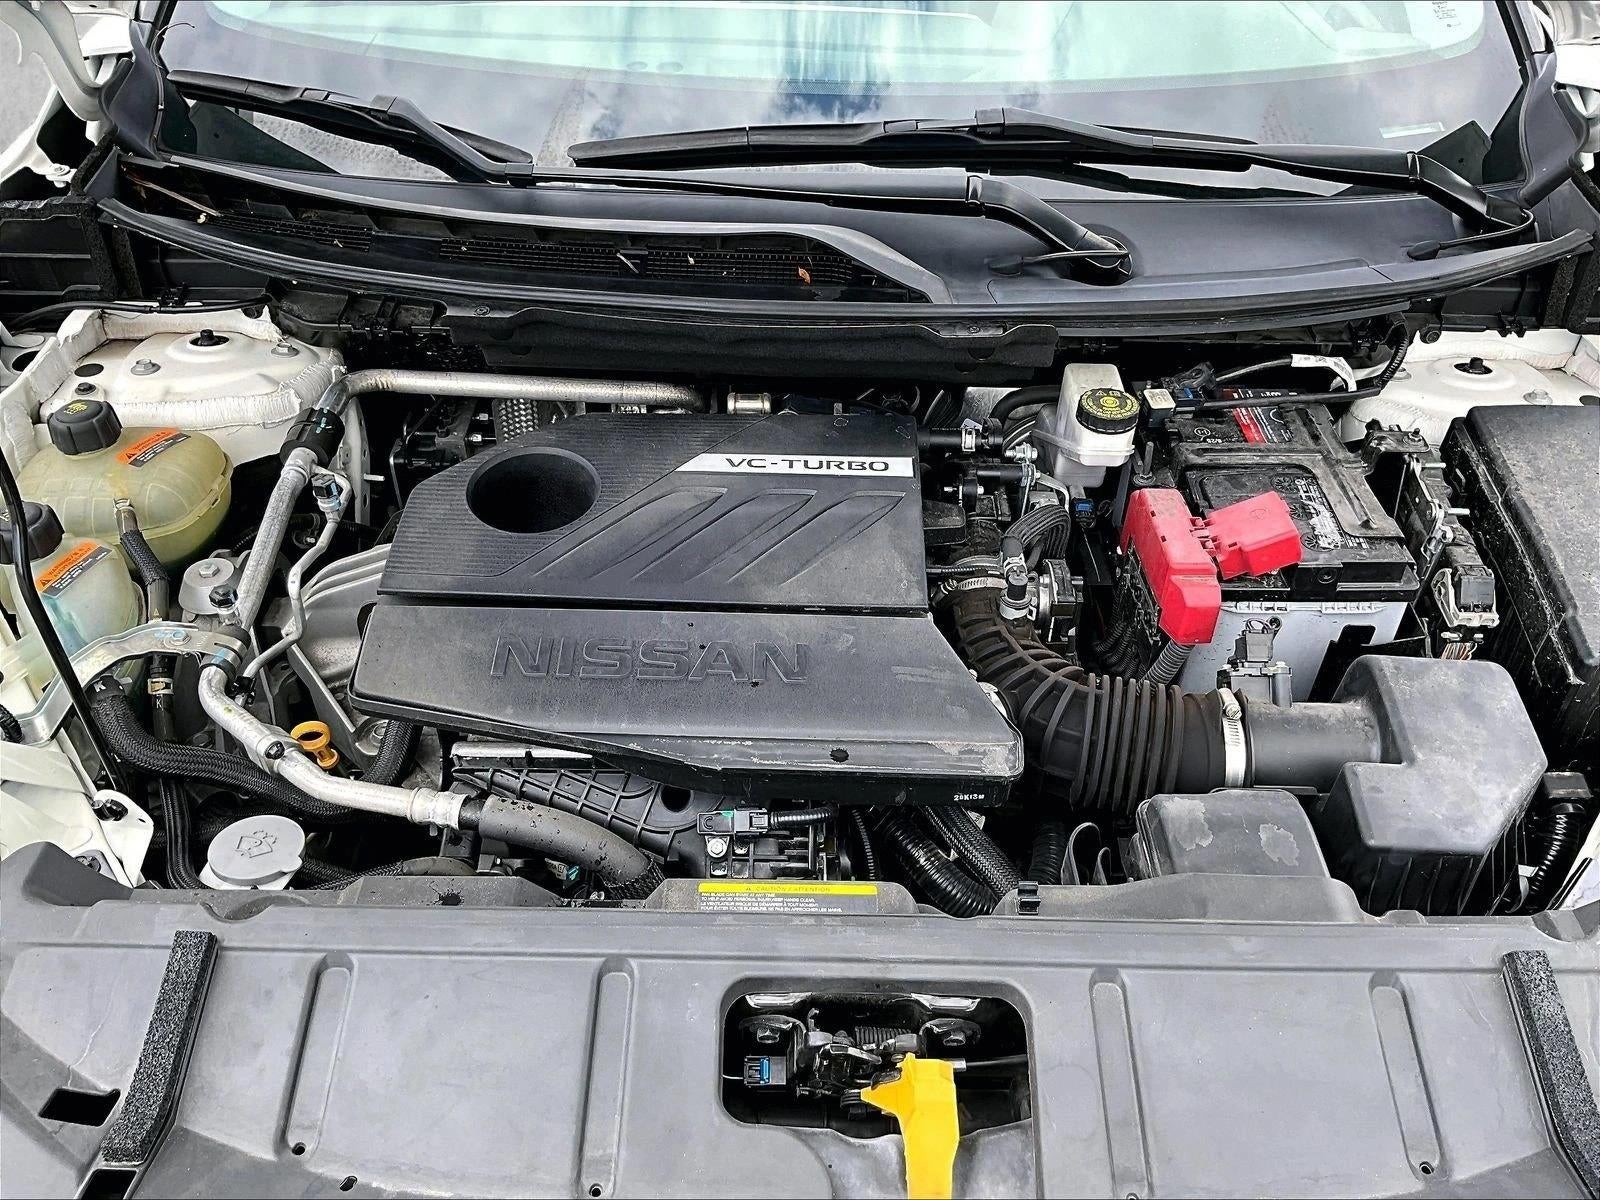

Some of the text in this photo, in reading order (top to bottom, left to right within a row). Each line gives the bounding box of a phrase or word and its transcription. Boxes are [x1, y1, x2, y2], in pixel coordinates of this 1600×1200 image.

[726, 457, 889, 472] VC-TURBO
[490, 636, 810, 683] NISSAN
[93, 680, 106, 692] K
[156, 698, 162, 709] K
